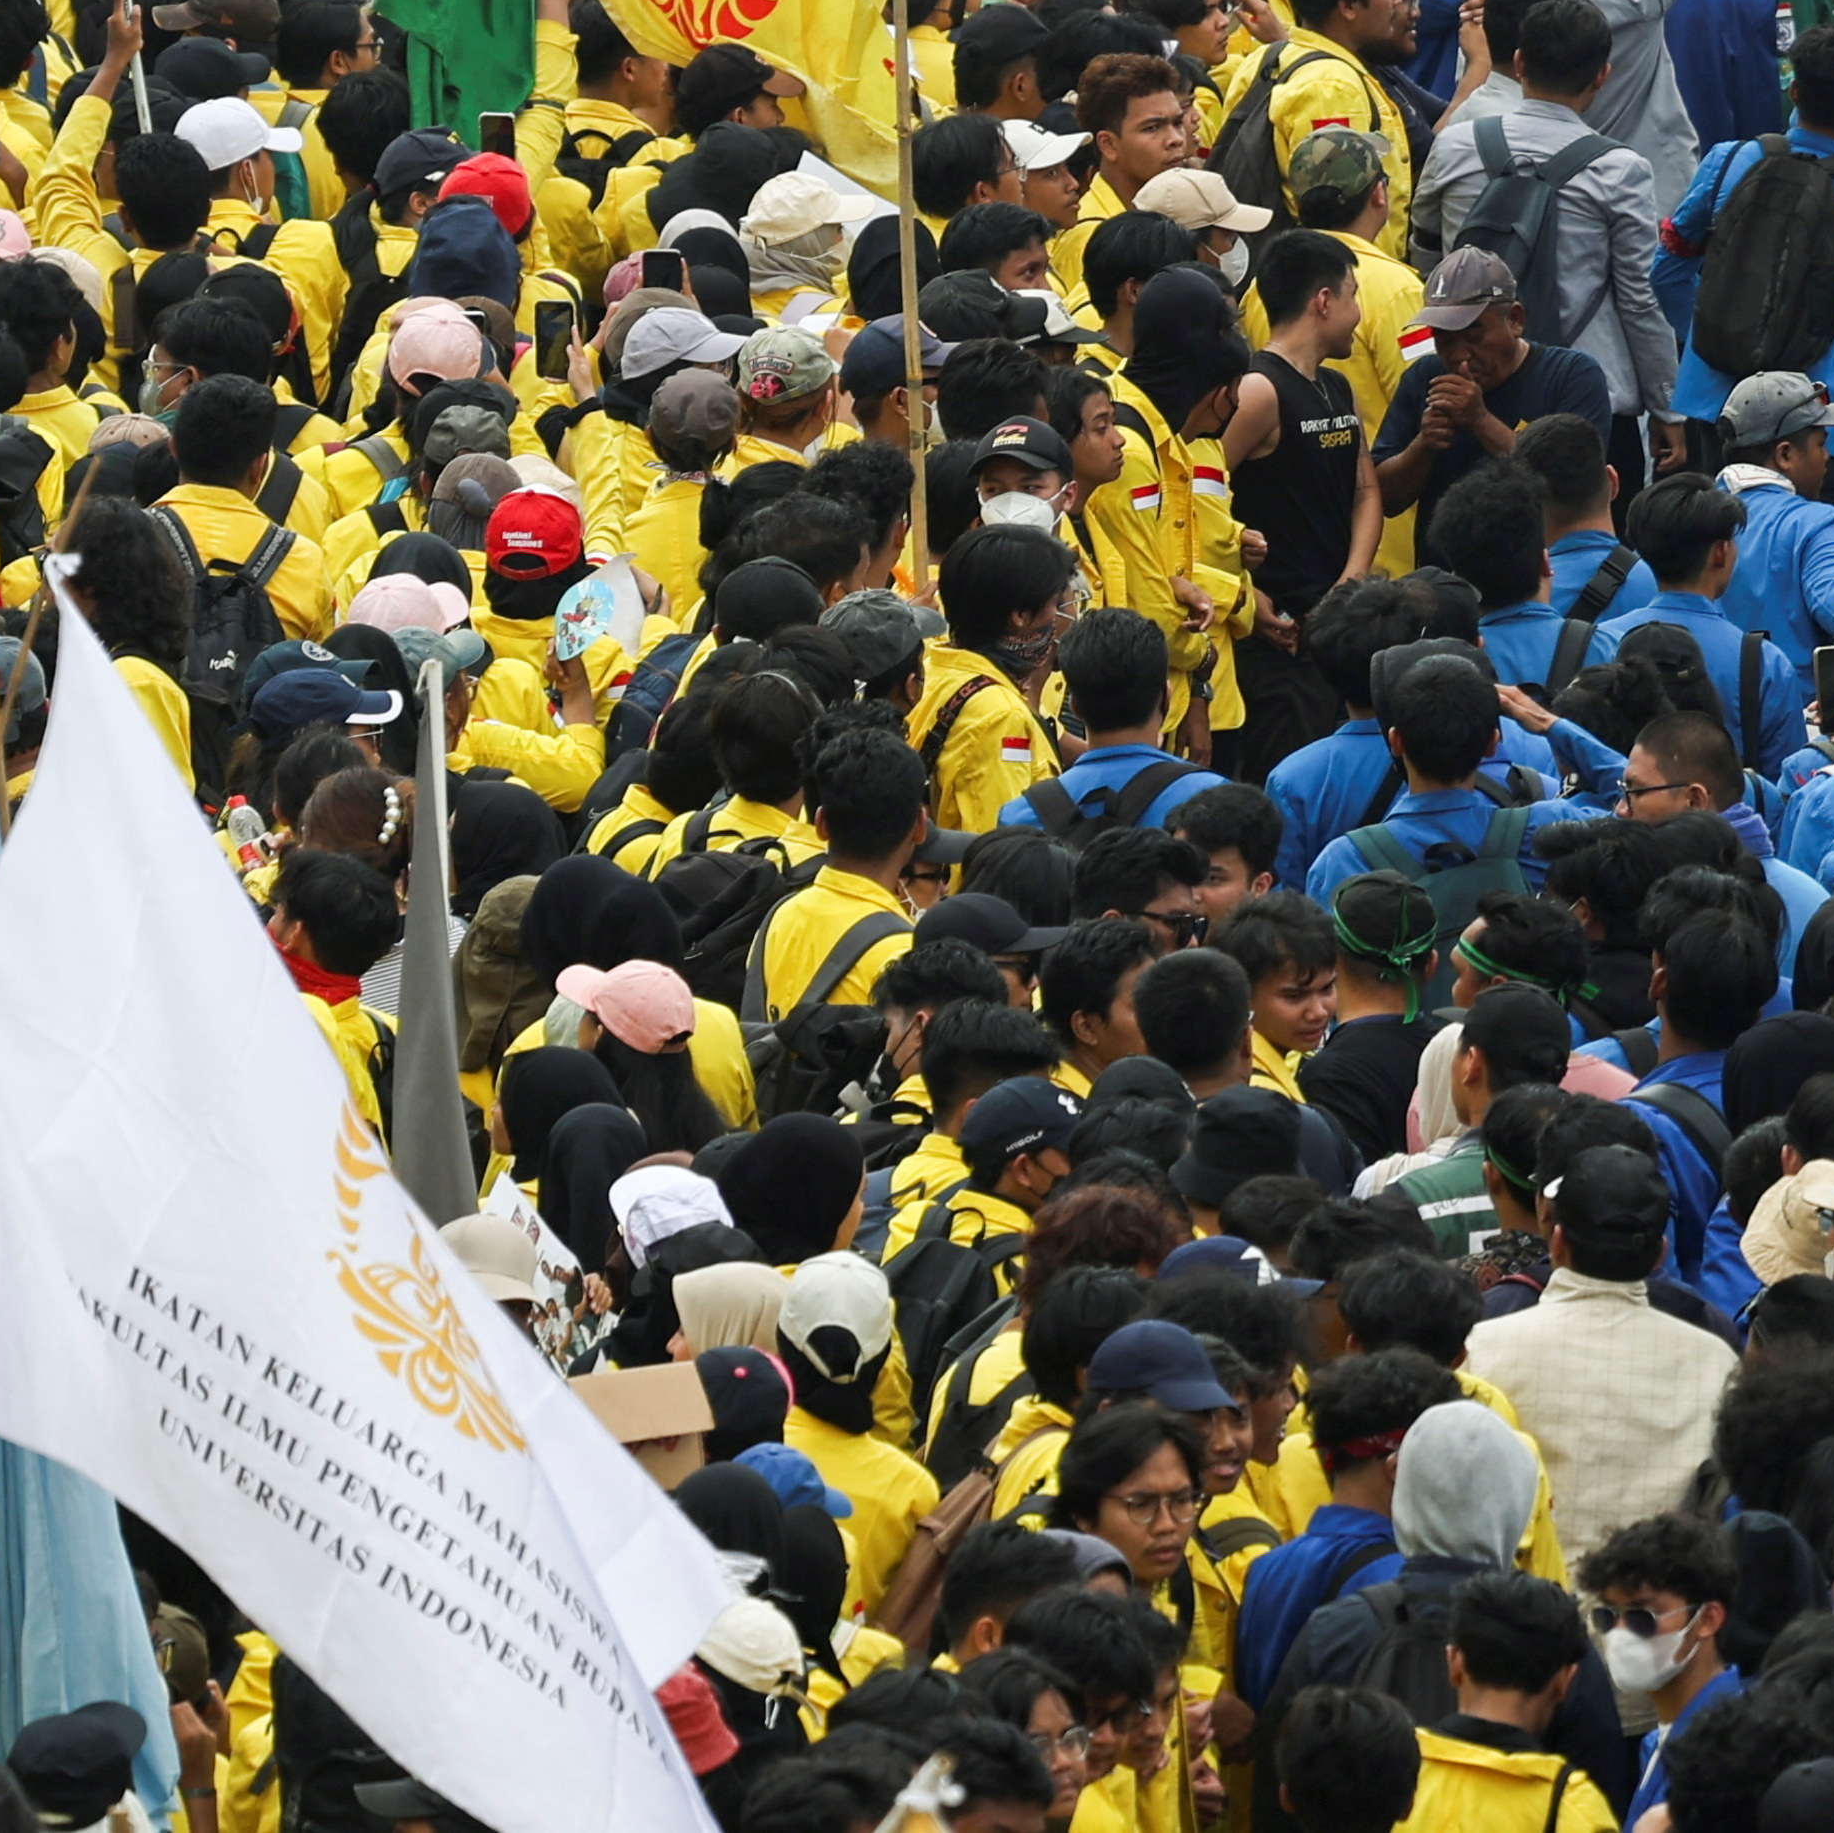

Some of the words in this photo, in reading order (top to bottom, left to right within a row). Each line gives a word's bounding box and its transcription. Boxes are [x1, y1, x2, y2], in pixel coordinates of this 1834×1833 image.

[1300, 418, 1331, 434] RAKYAT
[126, 1265, 255, 1365] IKATAN
[262, 1356, 450, 1495] KELUARGA
[456, 1488, 626, 1665] MAHASISWA
[157, 1406, 372, 1576] UNIVERSITAS
[376, 1562, 568, 1711] INDONESIA
[219, 1392, 308, 1466] ILMU
[317, 1457, 565, 1652] PENGETAHUAN
